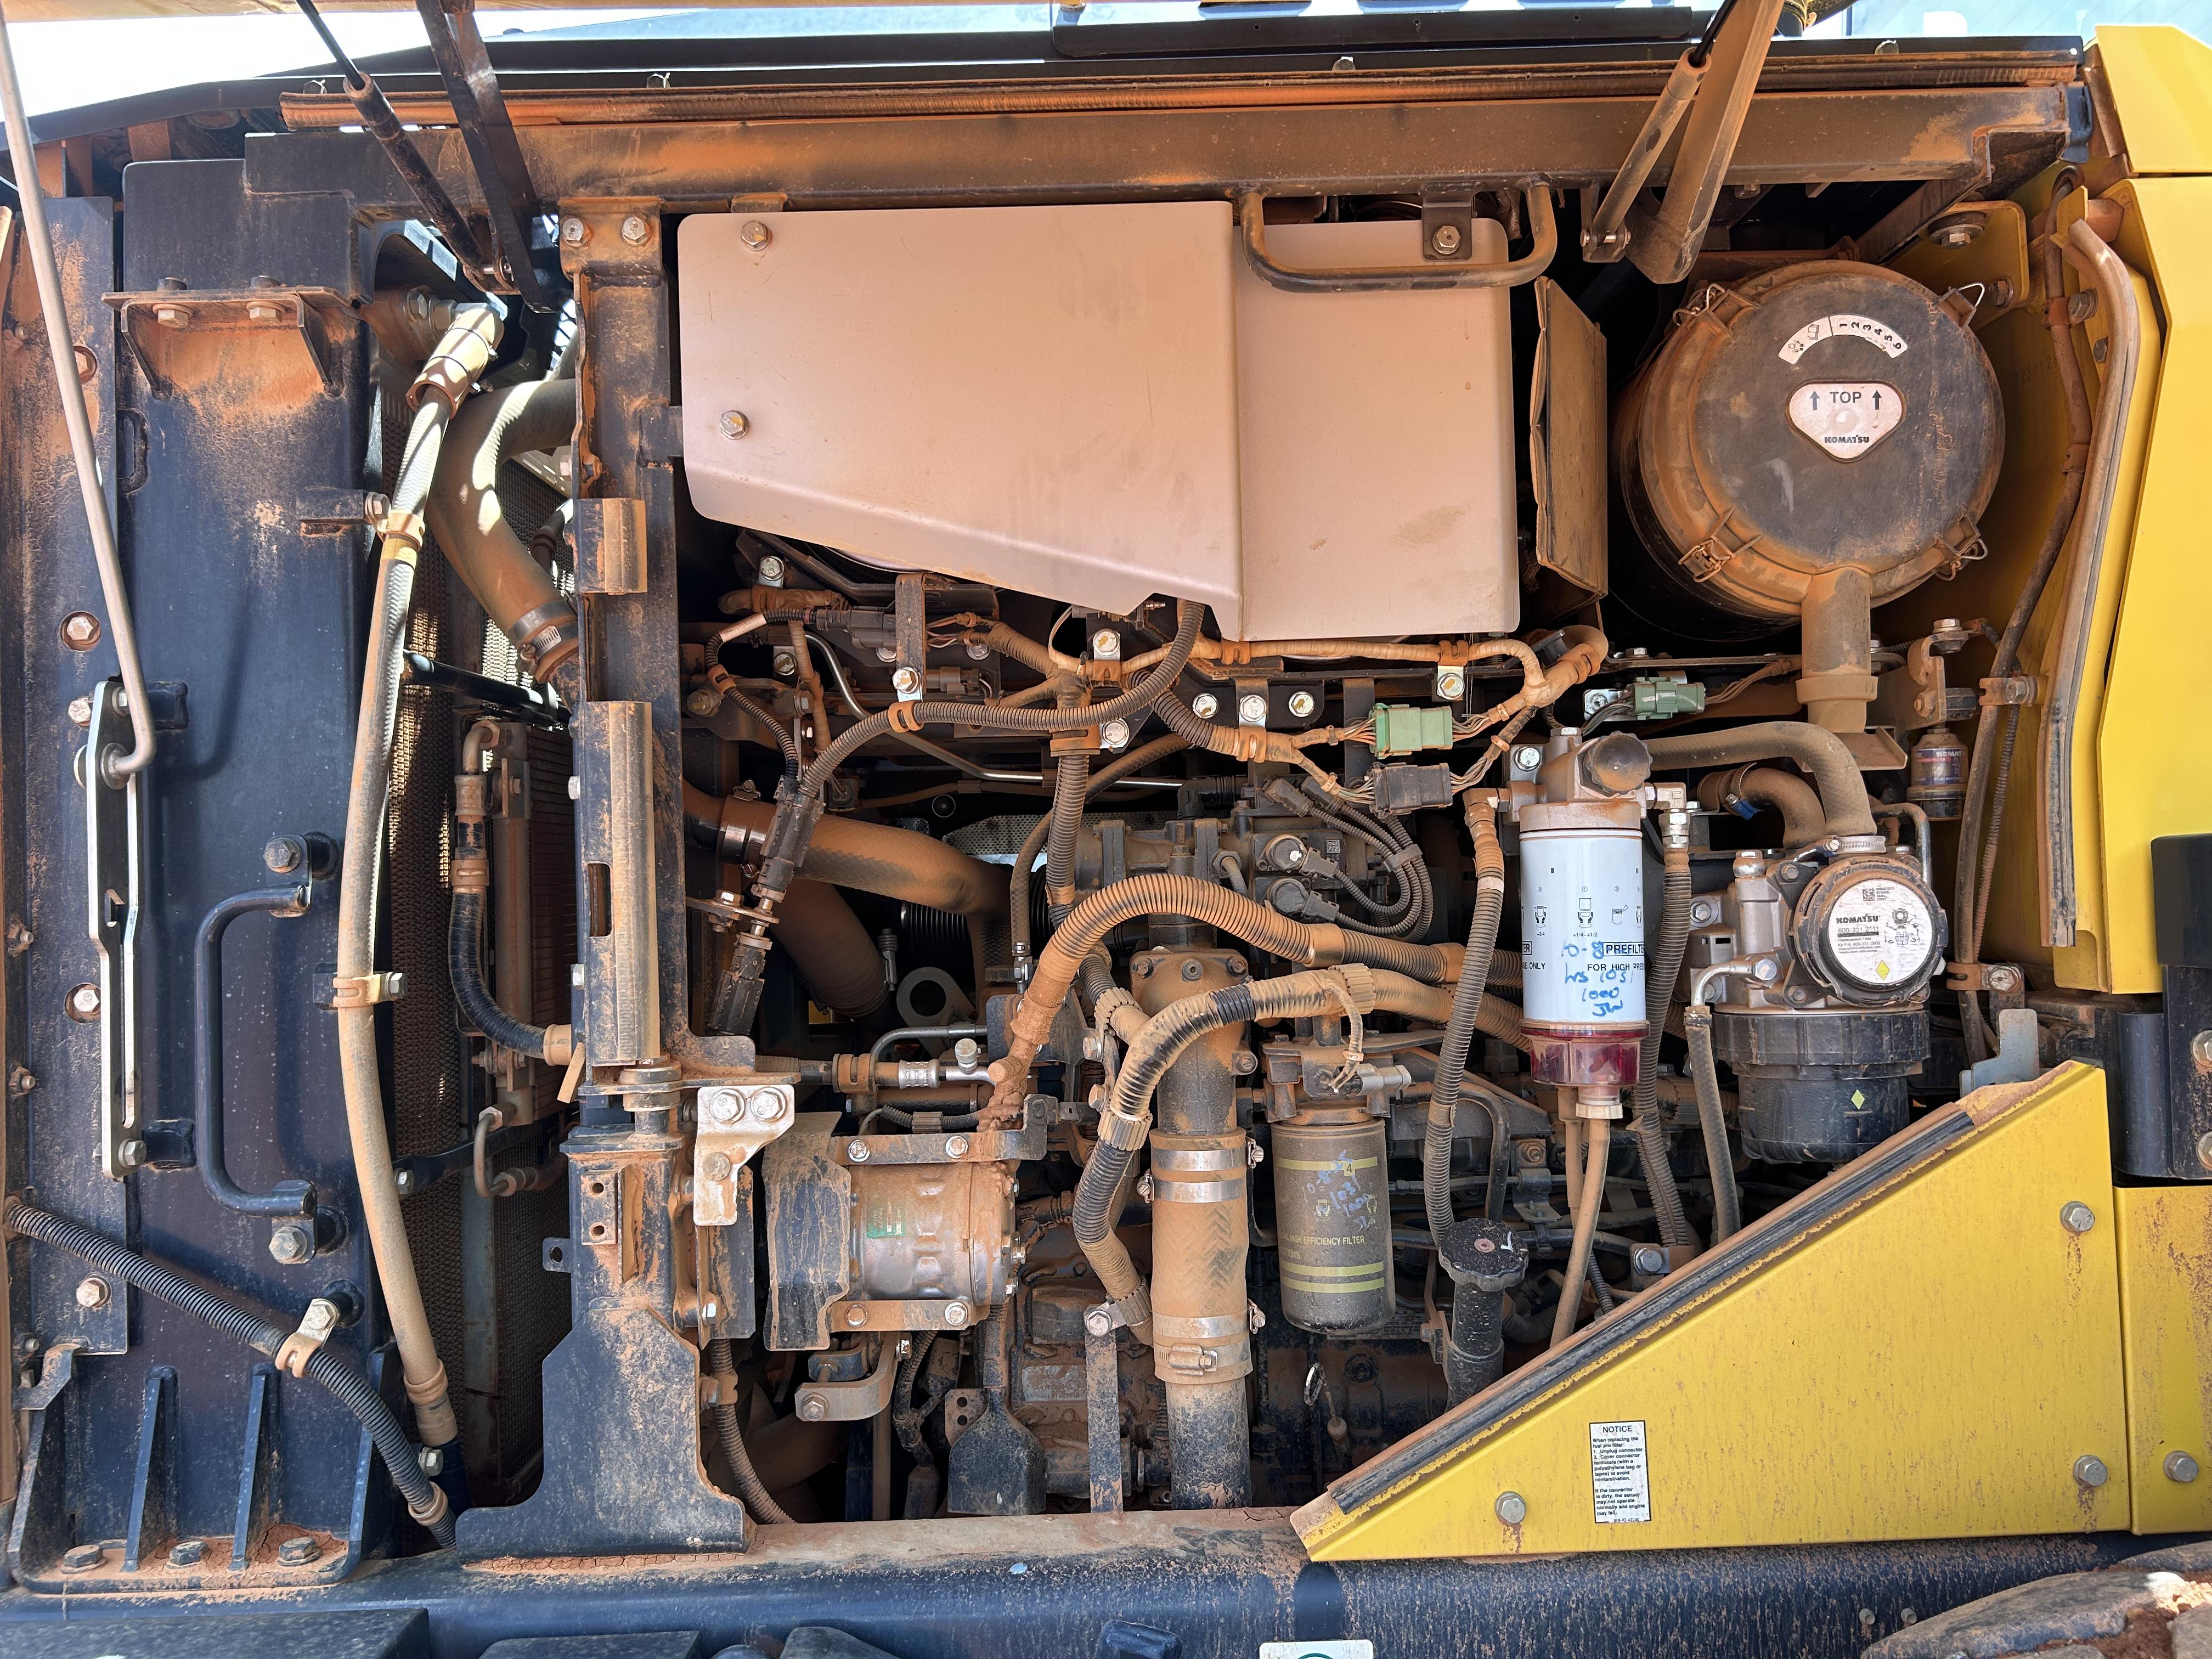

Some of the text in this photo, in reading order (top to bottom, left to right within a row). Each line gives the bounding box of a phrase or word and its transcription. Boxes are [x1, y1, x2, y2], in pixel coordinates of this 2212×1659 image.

[1830, 391, 1861, 404] TOP
[1824, 435, 1870, 443] KOMATSU
[1836, 913, 1878, 924] KOMATSU
[1582, 987, 1619, 1002] 1000
[1346, 1163, 1352, 1173] 4
[1303, 1237, 1341, 1246] EFFICIENCY
[1342, 1235, 1364, 1245] FILTER
